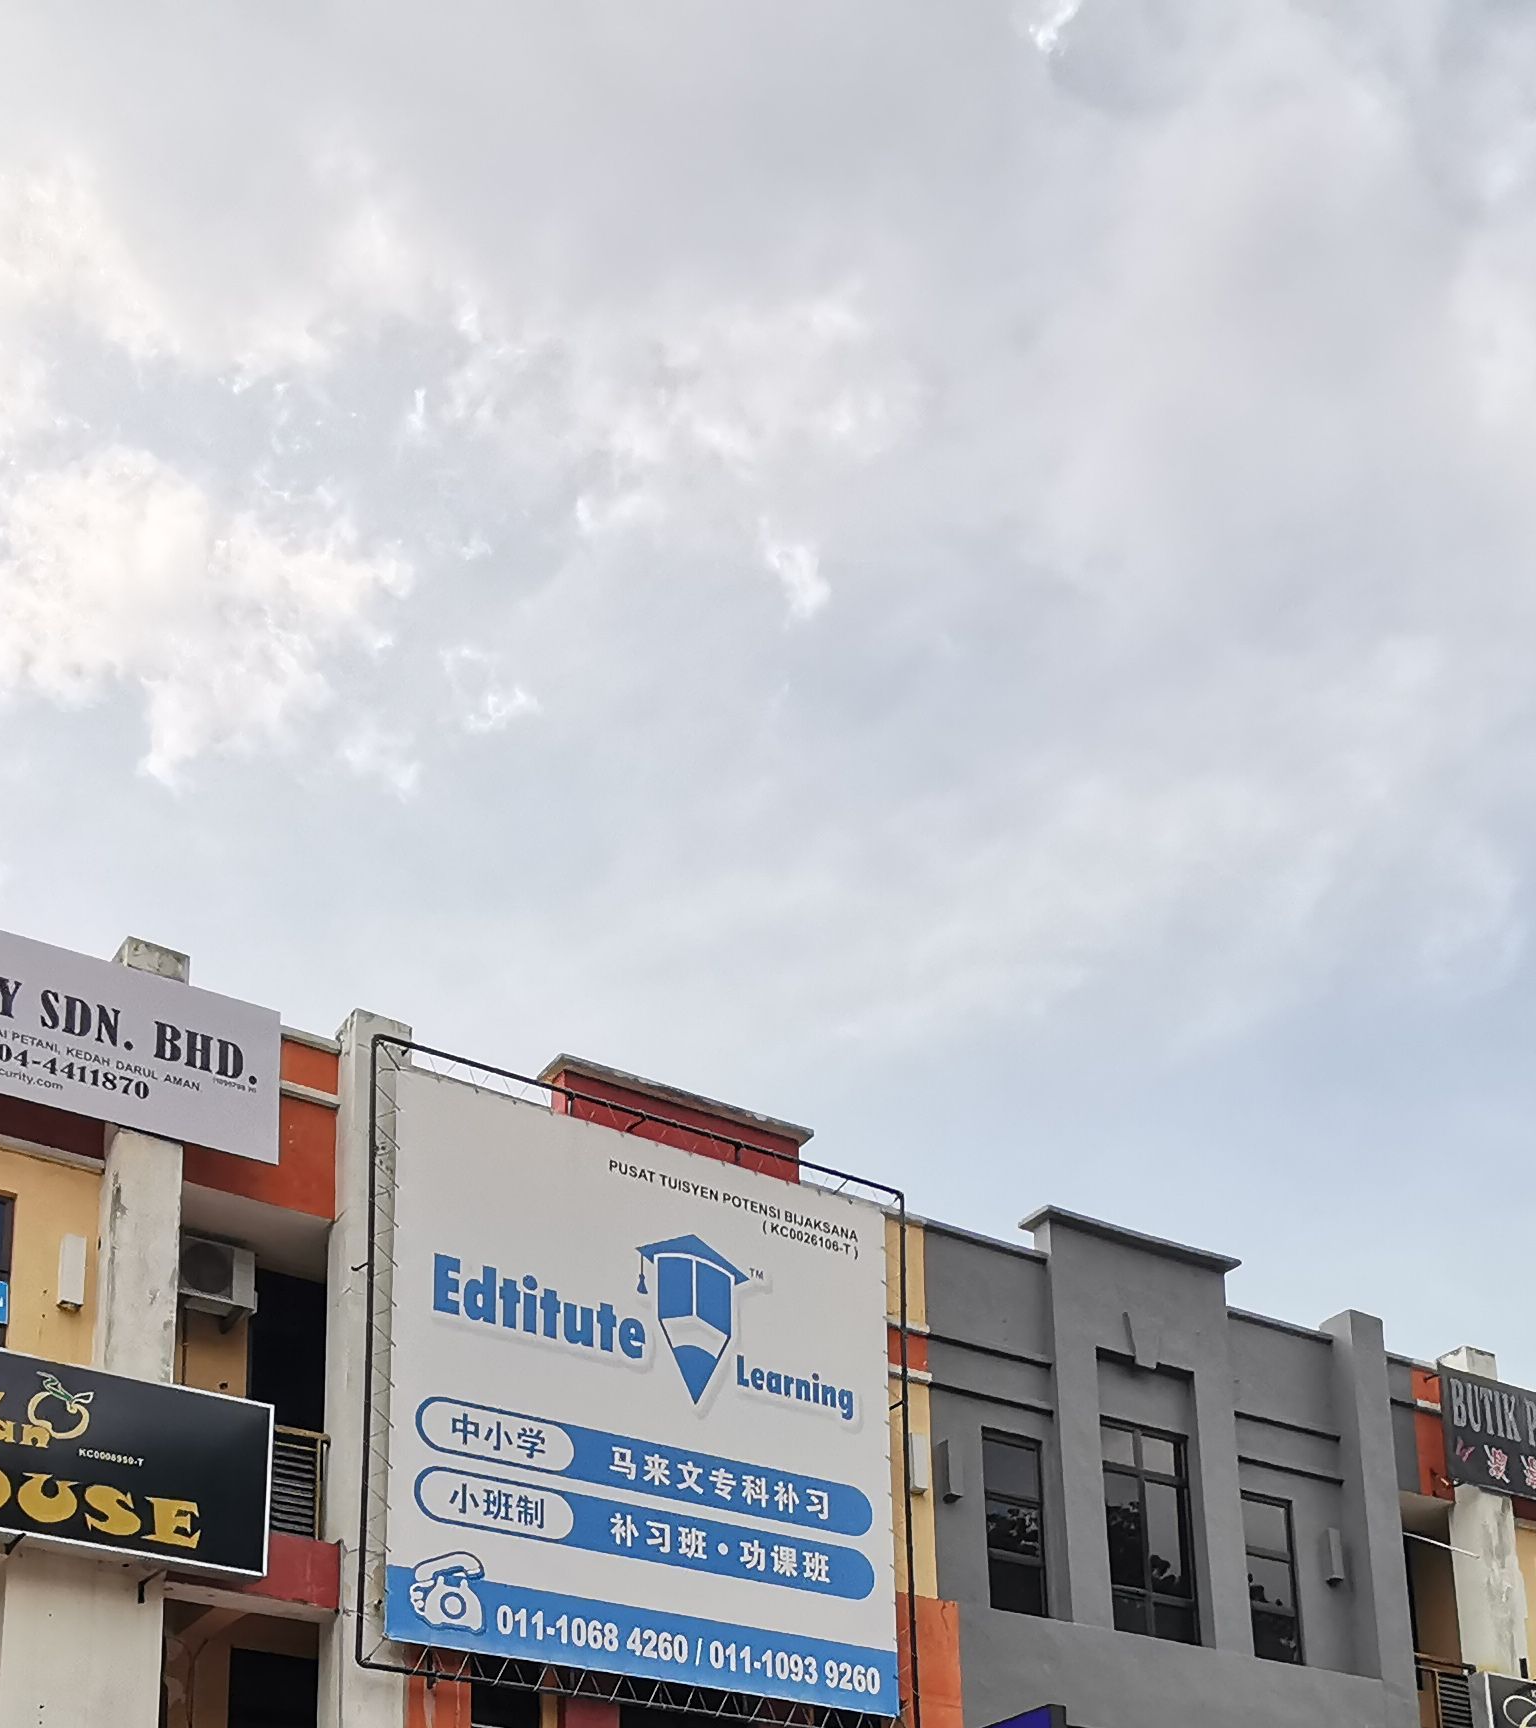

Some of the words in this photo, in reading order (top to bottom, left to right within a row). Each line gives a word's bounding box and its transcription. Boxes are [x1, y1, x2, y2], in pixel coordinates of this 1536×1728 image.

[12, 1032, 61, 1056] PETANI,
[66, 1047, 111, 1067] KEDAH
[116, 1060, 158, 1081] DARUL
[40, 990, 134, 1051] SDN.
[154, 1021, 257, 1085] BHD.
[608, 1158, 655, 1186] PUSAT
[660, 1174, 718, 1203] TUISYEN
[723, 1192, 781, 1220] POTENSI
[784, 1209, 859, 1243] BIJAKSANA
[433, 1252, 646, 1359] Edtitute
[736, 1355, 853, 1421] Learning
[450, 1413, 546, 1460] 中小学
[1450, 1378, 1521, 1442] BUTIK
[448, 1482, 545, 1530] 小班制
[609, 1445, 830, 1520] 马来文专科补习
[496, 1604, 619, 1652] 011-1068
[626, 1626, 688, 1665] 4260
[708, 1640, 818, 1686] 011-1093
[825, 1660, 882, 1697] 9260
